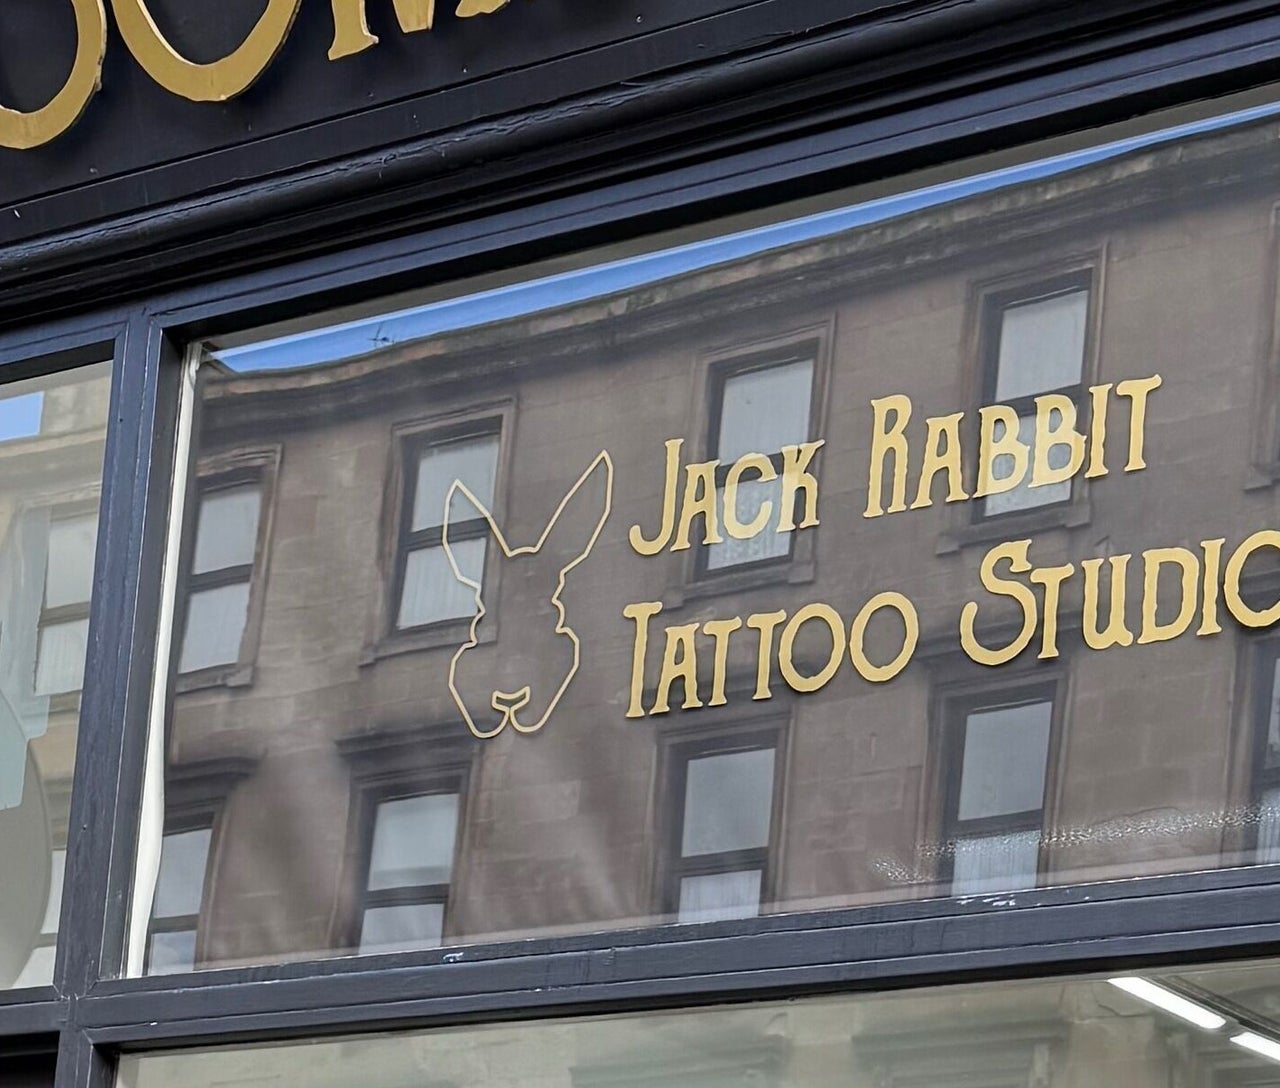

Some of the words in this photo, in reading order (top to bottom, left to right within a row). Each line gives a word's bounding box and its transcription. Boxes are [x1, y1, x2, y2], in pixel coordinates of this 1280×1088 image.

[629, 437, 826, 556] JACK
[862, 373, 1162, 518] RABBIT
[623, 591, 919, 718] TATTOO
